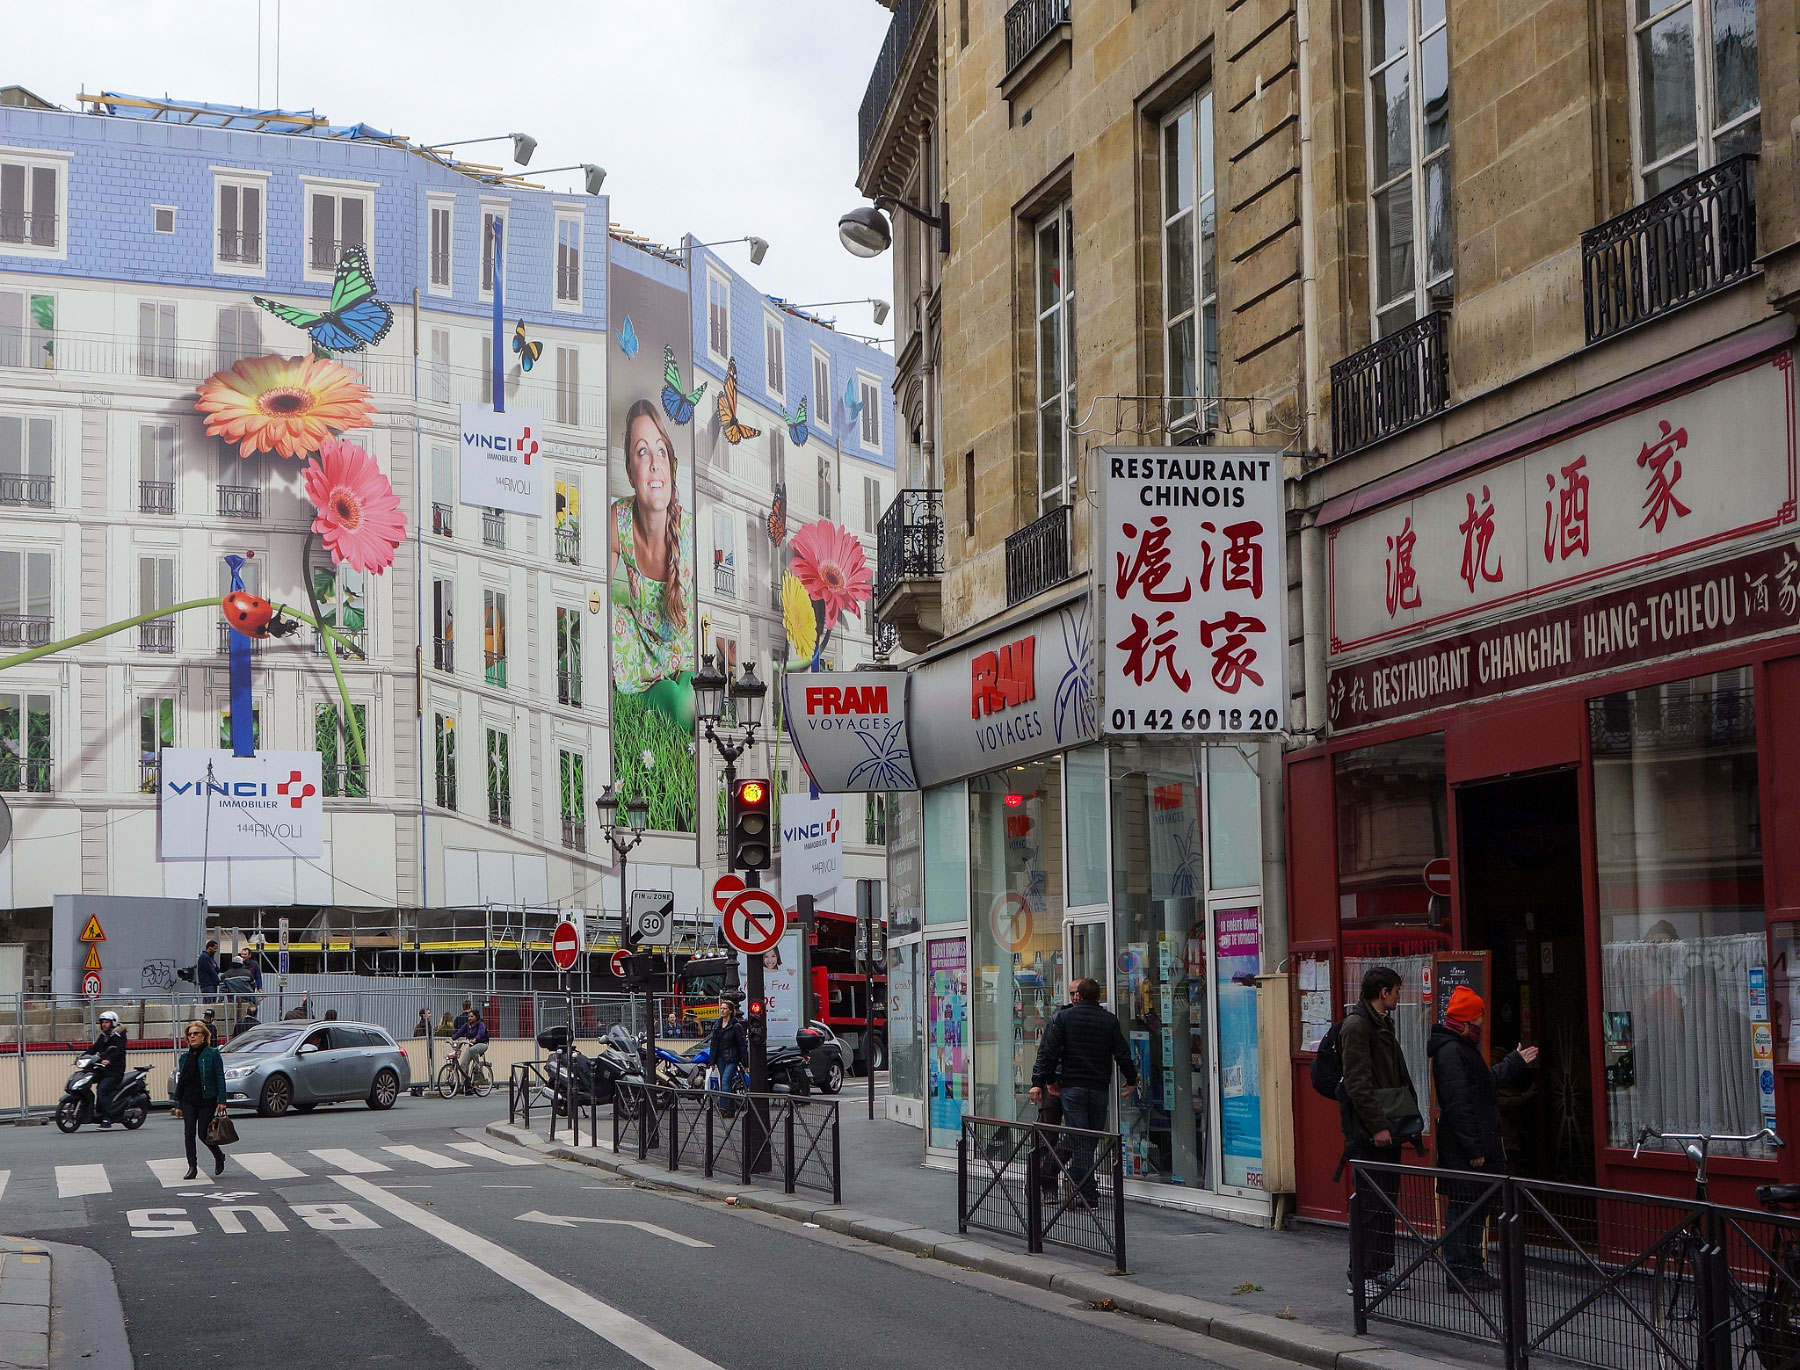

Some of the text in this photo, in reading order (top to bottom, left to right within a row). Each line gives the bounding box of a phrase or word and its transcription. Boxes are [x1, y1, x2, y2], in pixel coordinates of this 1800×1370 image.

[463, 432, 512, 452] VINCI
[486, 453, 518, 463] IMMOBILIER
[1111, 457, 1271, 481] RESTAURANT
[1139, 485, 1245, 508] CHINOIS
[1372, 646, 1471, 709] RESTAURANT
[1478, 620, 1571, 683] CHANGHAI
[1583, 574, 1737, 659] HANG-TCHEOU
[971, 635, 1036, 719] FRAM
[805, 686, 889, 715] FRAM
[807, 717, 891, 731] VOYAGES
[1111, 709, 1279, 730] 01 42 60 18 20
[976, 710, 1043, 753] VOYAGES
[167, 781, 267, 797] VINCI
[219, 800, 278, 809] IMMOBILIER
[783, 822, 824, 843] VINCI
[644, 918, 659, 929] 30
[87, 981, 99, 994] 30
[771, 980, 791, 991] Free
[126, 1203, 383, 1238] BUS
